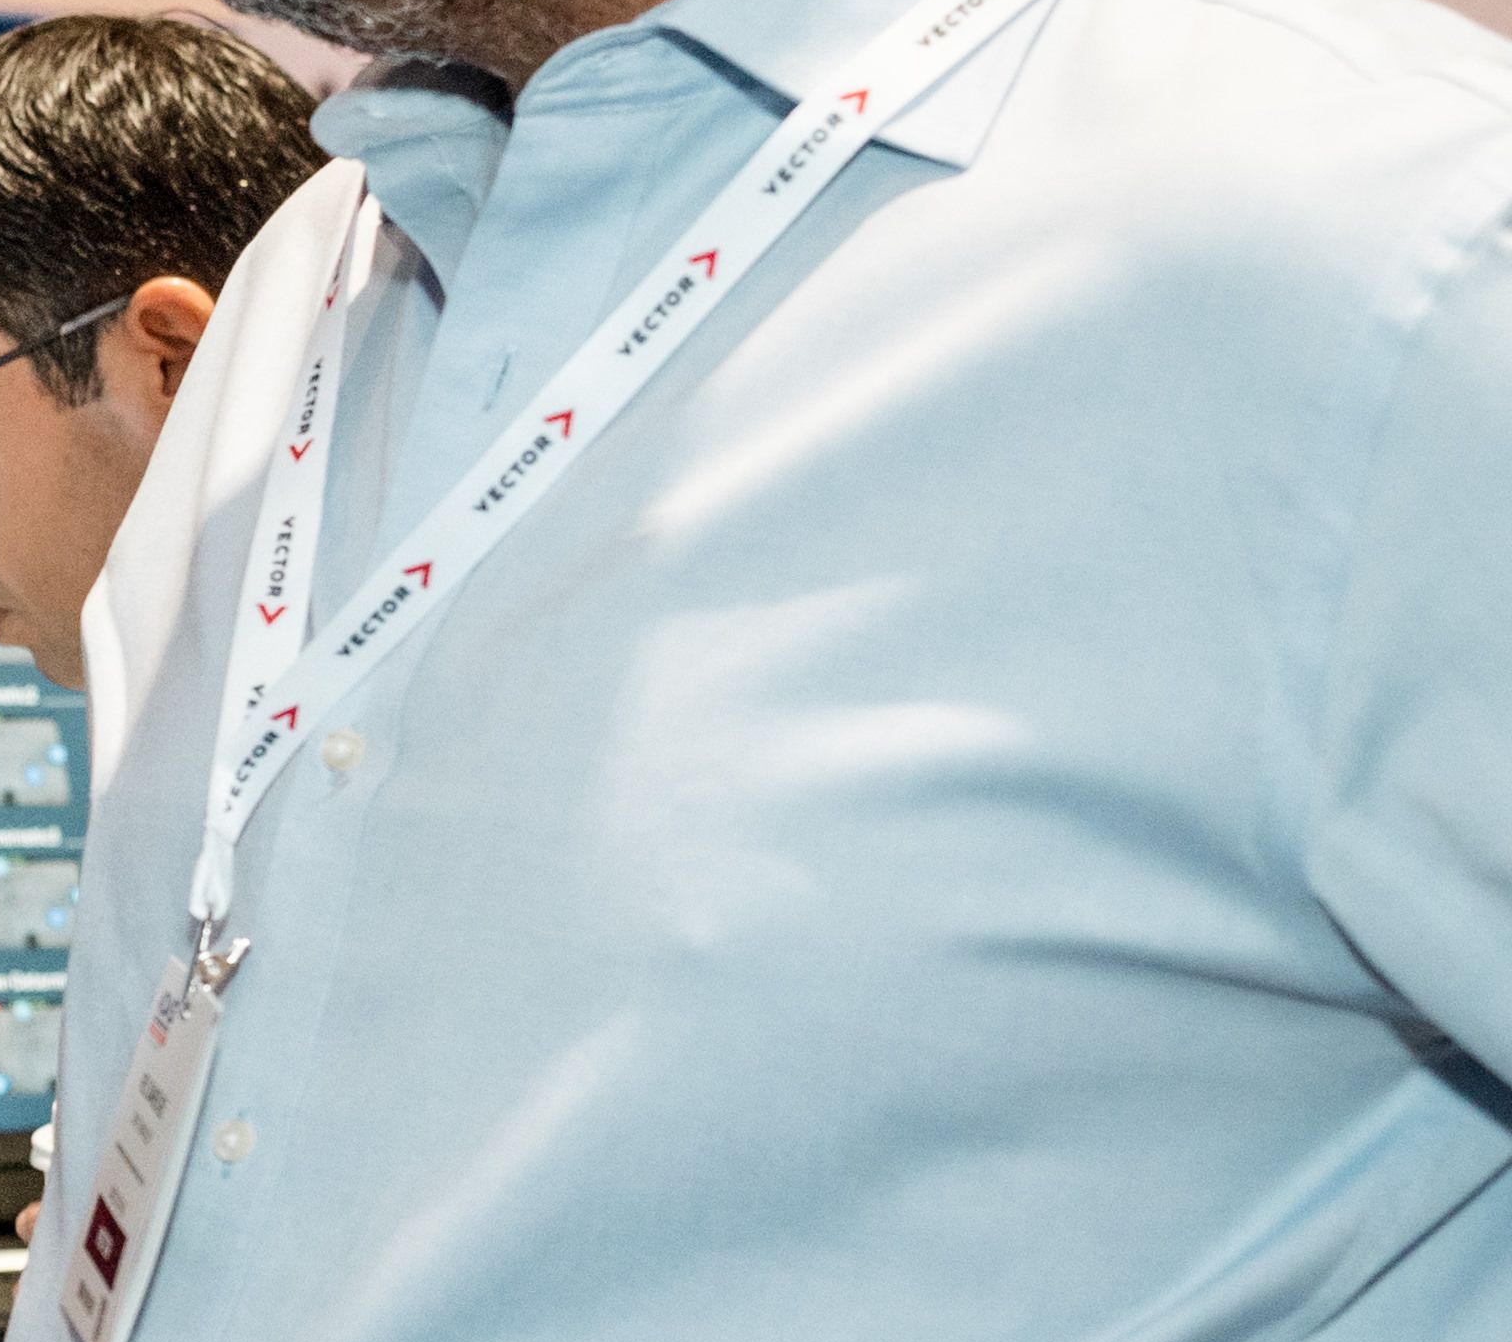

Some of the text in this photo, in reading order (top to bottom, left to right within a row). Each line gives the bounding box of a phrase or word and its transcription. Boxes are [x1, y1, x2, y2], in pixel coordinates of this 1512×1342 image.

[761, 112, 844, 196] VECTOR
[617, 274, 696, 358] VECTOR
[299, 357, 324, 435] VECTOR
[473, 433, 554, 514] VECTOR
[268, 515, 296, 598] VECTOR
[336, 584, 411, 659] VECTOR
[224, 730, 280, 815] VECTOR
